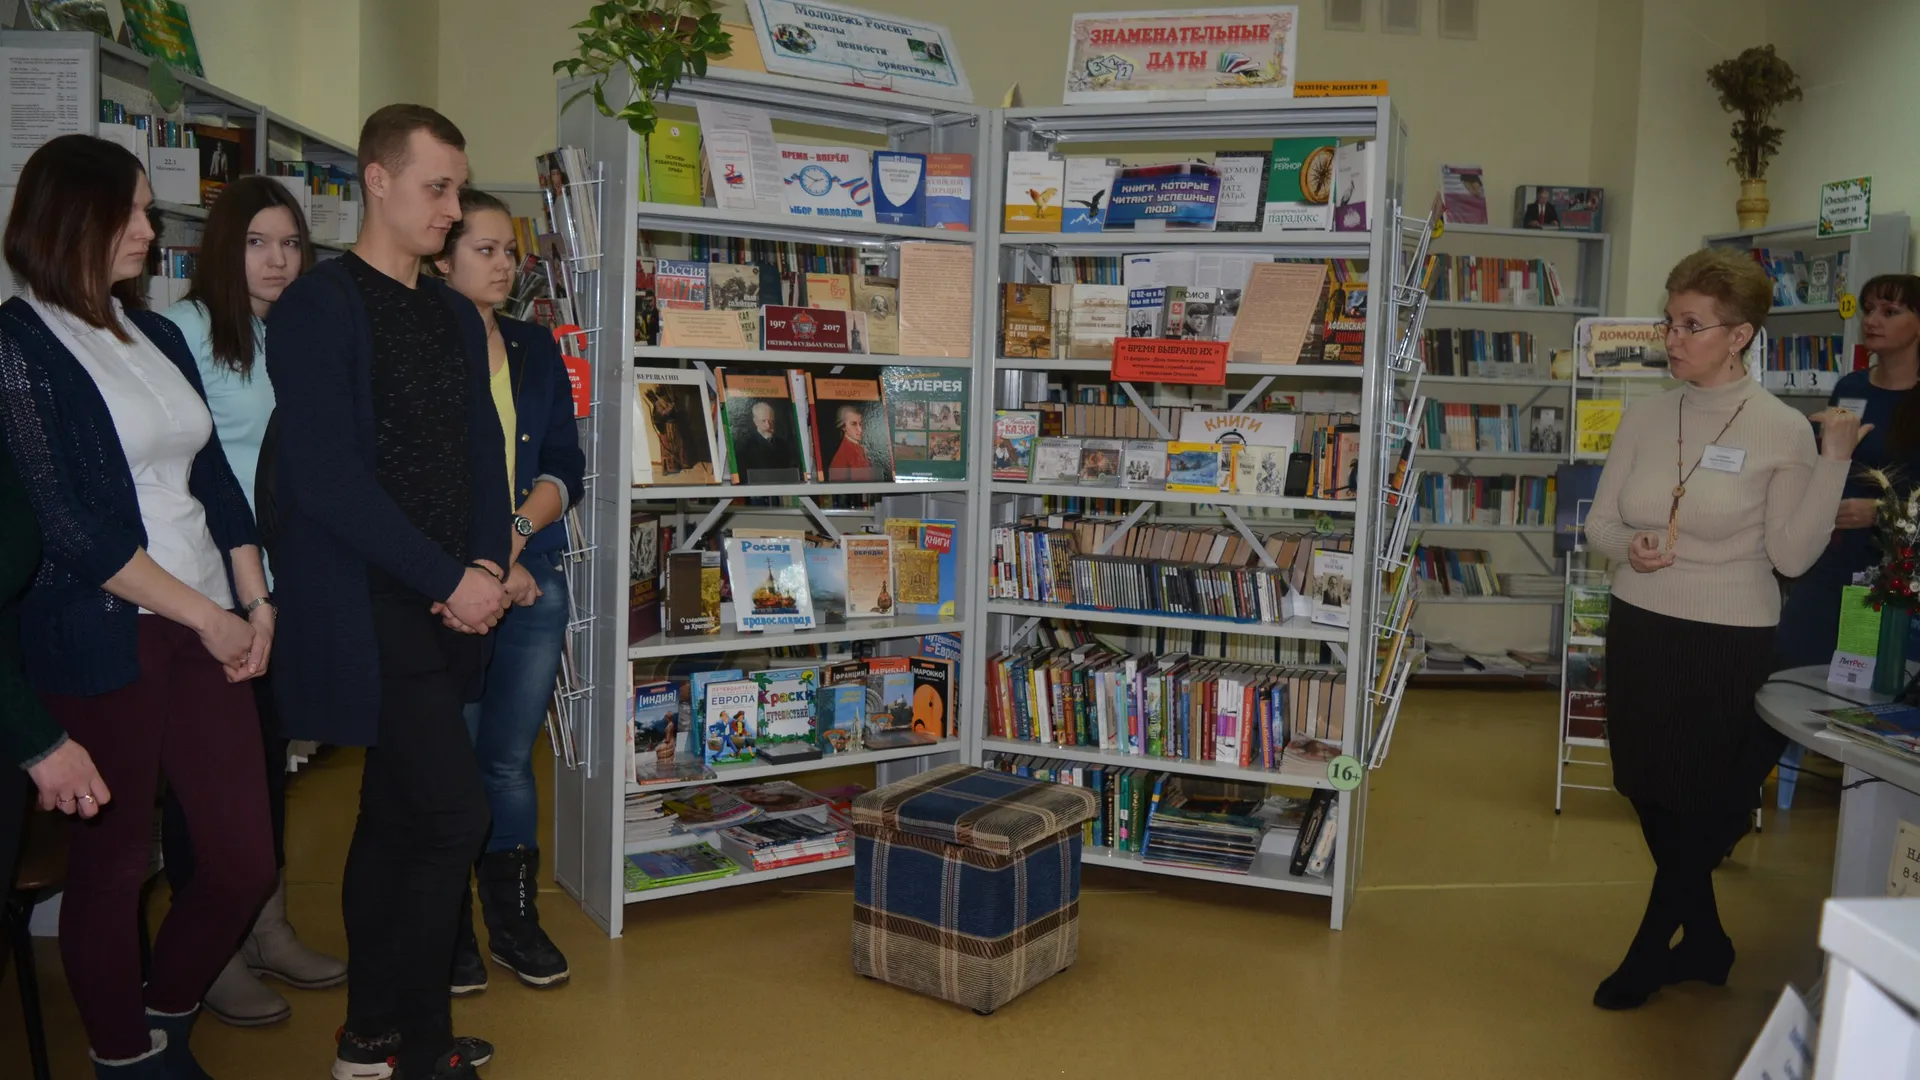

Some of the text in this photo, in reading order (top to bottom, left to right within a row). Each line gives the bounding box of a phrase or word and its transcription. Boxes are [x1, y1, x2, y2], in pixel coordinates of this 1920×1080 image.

[794, 4, 913, 36] Молодежь России:
[804, 21, 845, 35] идеалы
[1090, 24, 1270, 44] ЗНАМЕНАТЕЛЬНЫЕ
[836, 39, 888, 55] ценности
[1147, 50, 1208, 69] ДАТЫ
[877, 59, 936, 77] ориентиры
[782, 150, 808, 160] ВРЕМЯ
[816, 152, 850, 163] ВПЕРЁД!
[1274, 163, 1302, 171] РЕЙНОР
[1121, 181, 1210, 193] КНИГИ, КОТОРЫЕ
[1112, 193, 1216, 206] ЧИТАЮТ УСПЕШНЫЕ
[1824, 193, 1864, 206] Юношество
[789, 205, 863, 218] ЫБОР МОЛОДЁЖИ
[1145, 205, 1177, 214] ЛЮДИ
[1828, 207, 1850, 215] читает
[1267, 213, 1319, 226] парадокс
[1834, 216, 1862, 226] советует
[657, 259, 706, 277] Россия
[1176, 291, 1209, 299] ГРОМОВ
[769, 320, 786, 329] 1917
[823, 324, 841, 333] 2017
[1327, 320, 1366, 331] АФГАНСКАЯ
[1127, 345, 1156, 354] ВРЕМЯ
[1158, 345, 1198, 355] ВЫБРАЛО
[1199, 347, 1213, 356] ИХ
[896, 380, 962, 392] ГАЛЕРЕЯ
[1784, 374, 1796, 388] Д
[1204, 415, 1263, 432] КНИГИ
[740, 541, 791, 552] Россия
[925, 535, 950, 548] КНИГИ
[743, 615, 812, 629] православная
[711, 695, 756, 706] ЕВРОПА
[758, 689, 814, 707] Краски
[766, 706, 810, 723] путешествий
[1332, 763, 1361, 781] 16+
